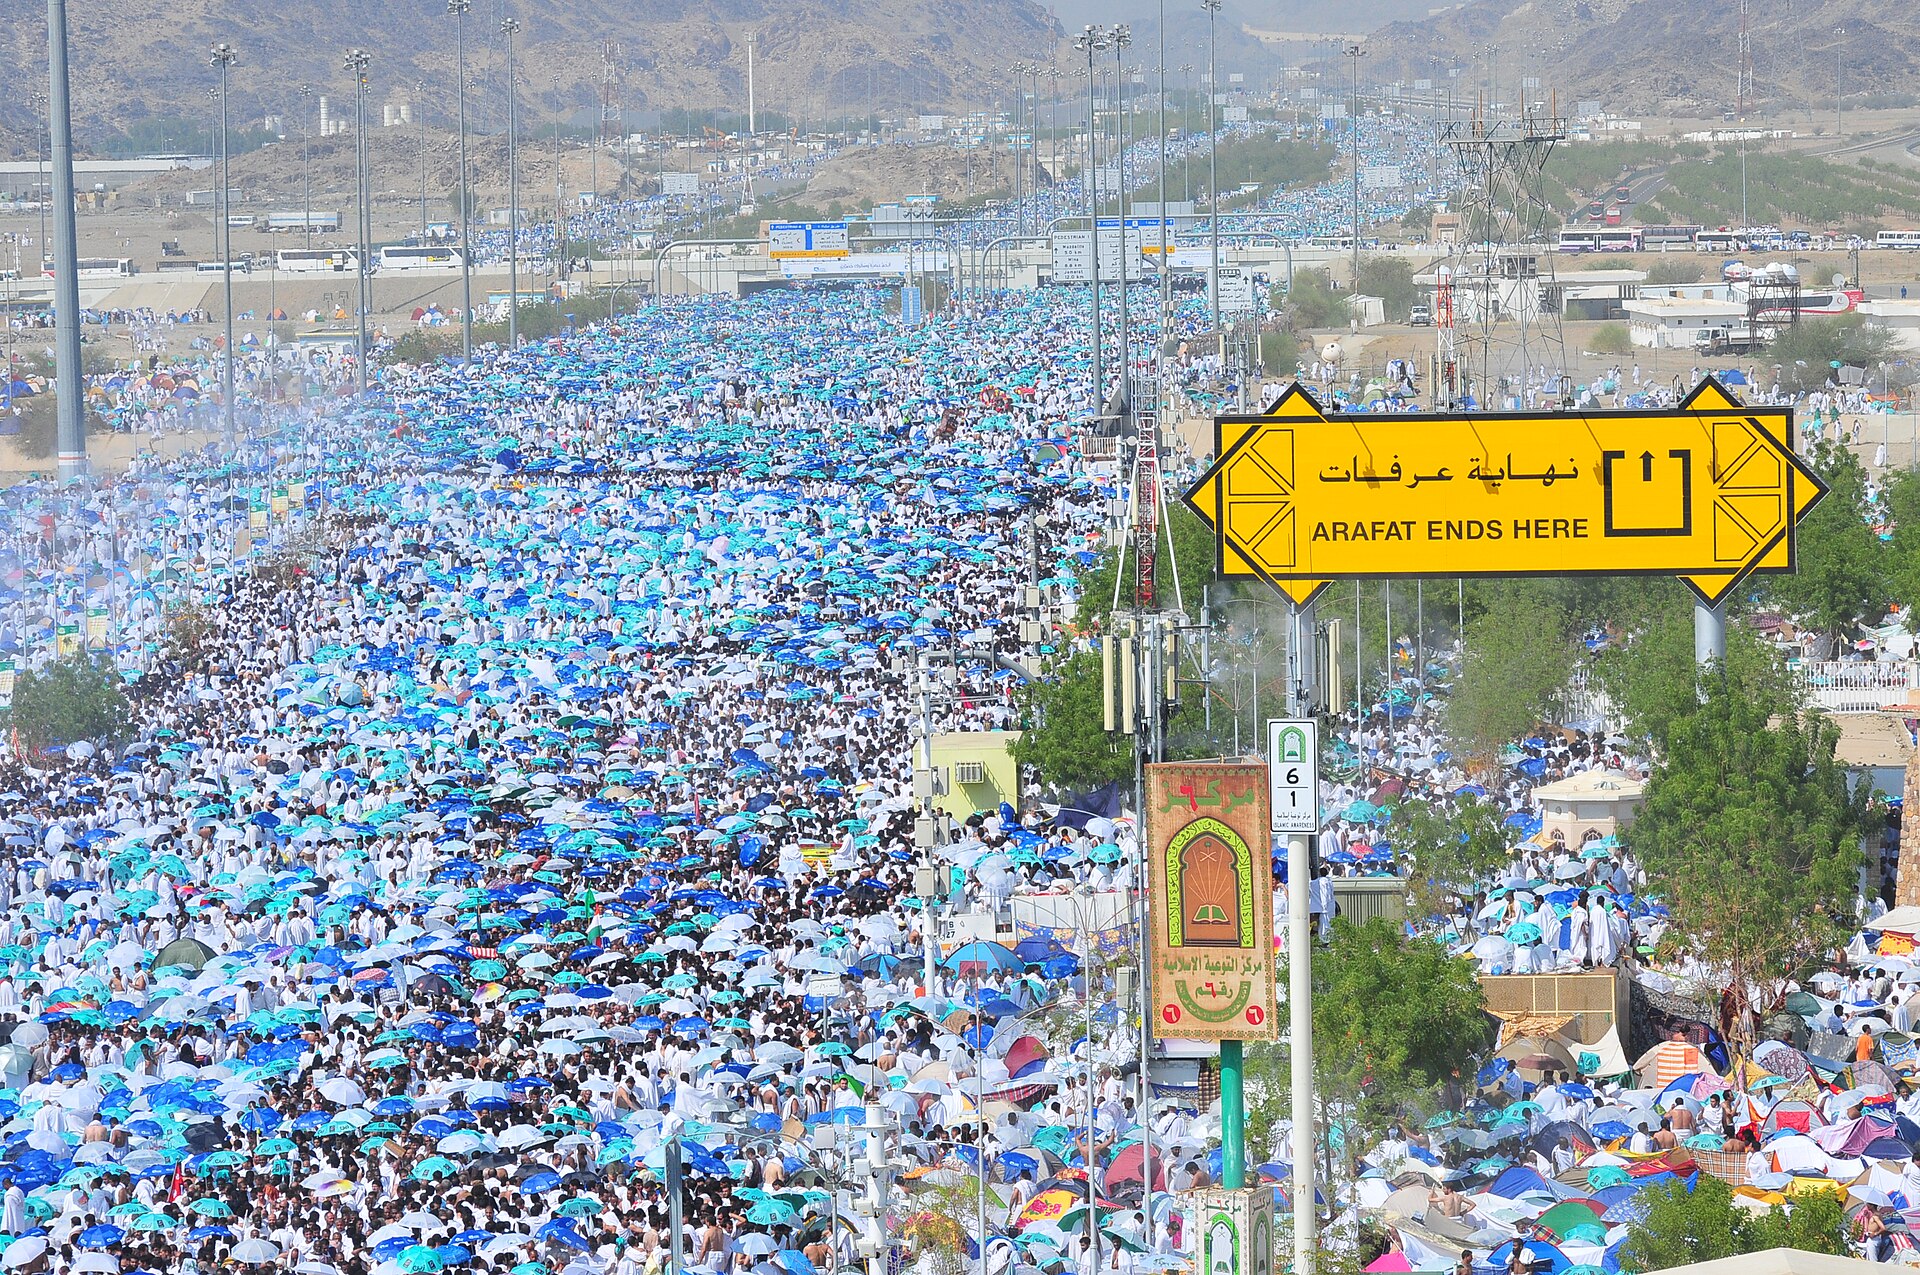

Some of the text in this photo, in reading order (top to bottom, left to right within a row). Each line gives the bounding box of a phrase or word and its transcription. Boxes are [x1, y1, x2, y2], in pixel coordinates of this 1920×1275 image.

[1319, 453, 1579, 489] نهاية عرفات
[1311, 517, 1589, 542] ARAFAT ENDS HERE
[1286, 767, 1299, 784] 6
[1158, 779, 1255, 814] مركز
[1290, 790, 1296, 807] 1
[946, 931, 956, 939] 27
[1163, 954, 1262, 976] مركز التوعية الإسلامية
[1195, 981, 1234, 999] رقم
[1165, 1007, 1178, 1022] ٦
[1249, 1008, 1260, 1024] ٦
[1200, 1196, 1242, 1214] مركز
